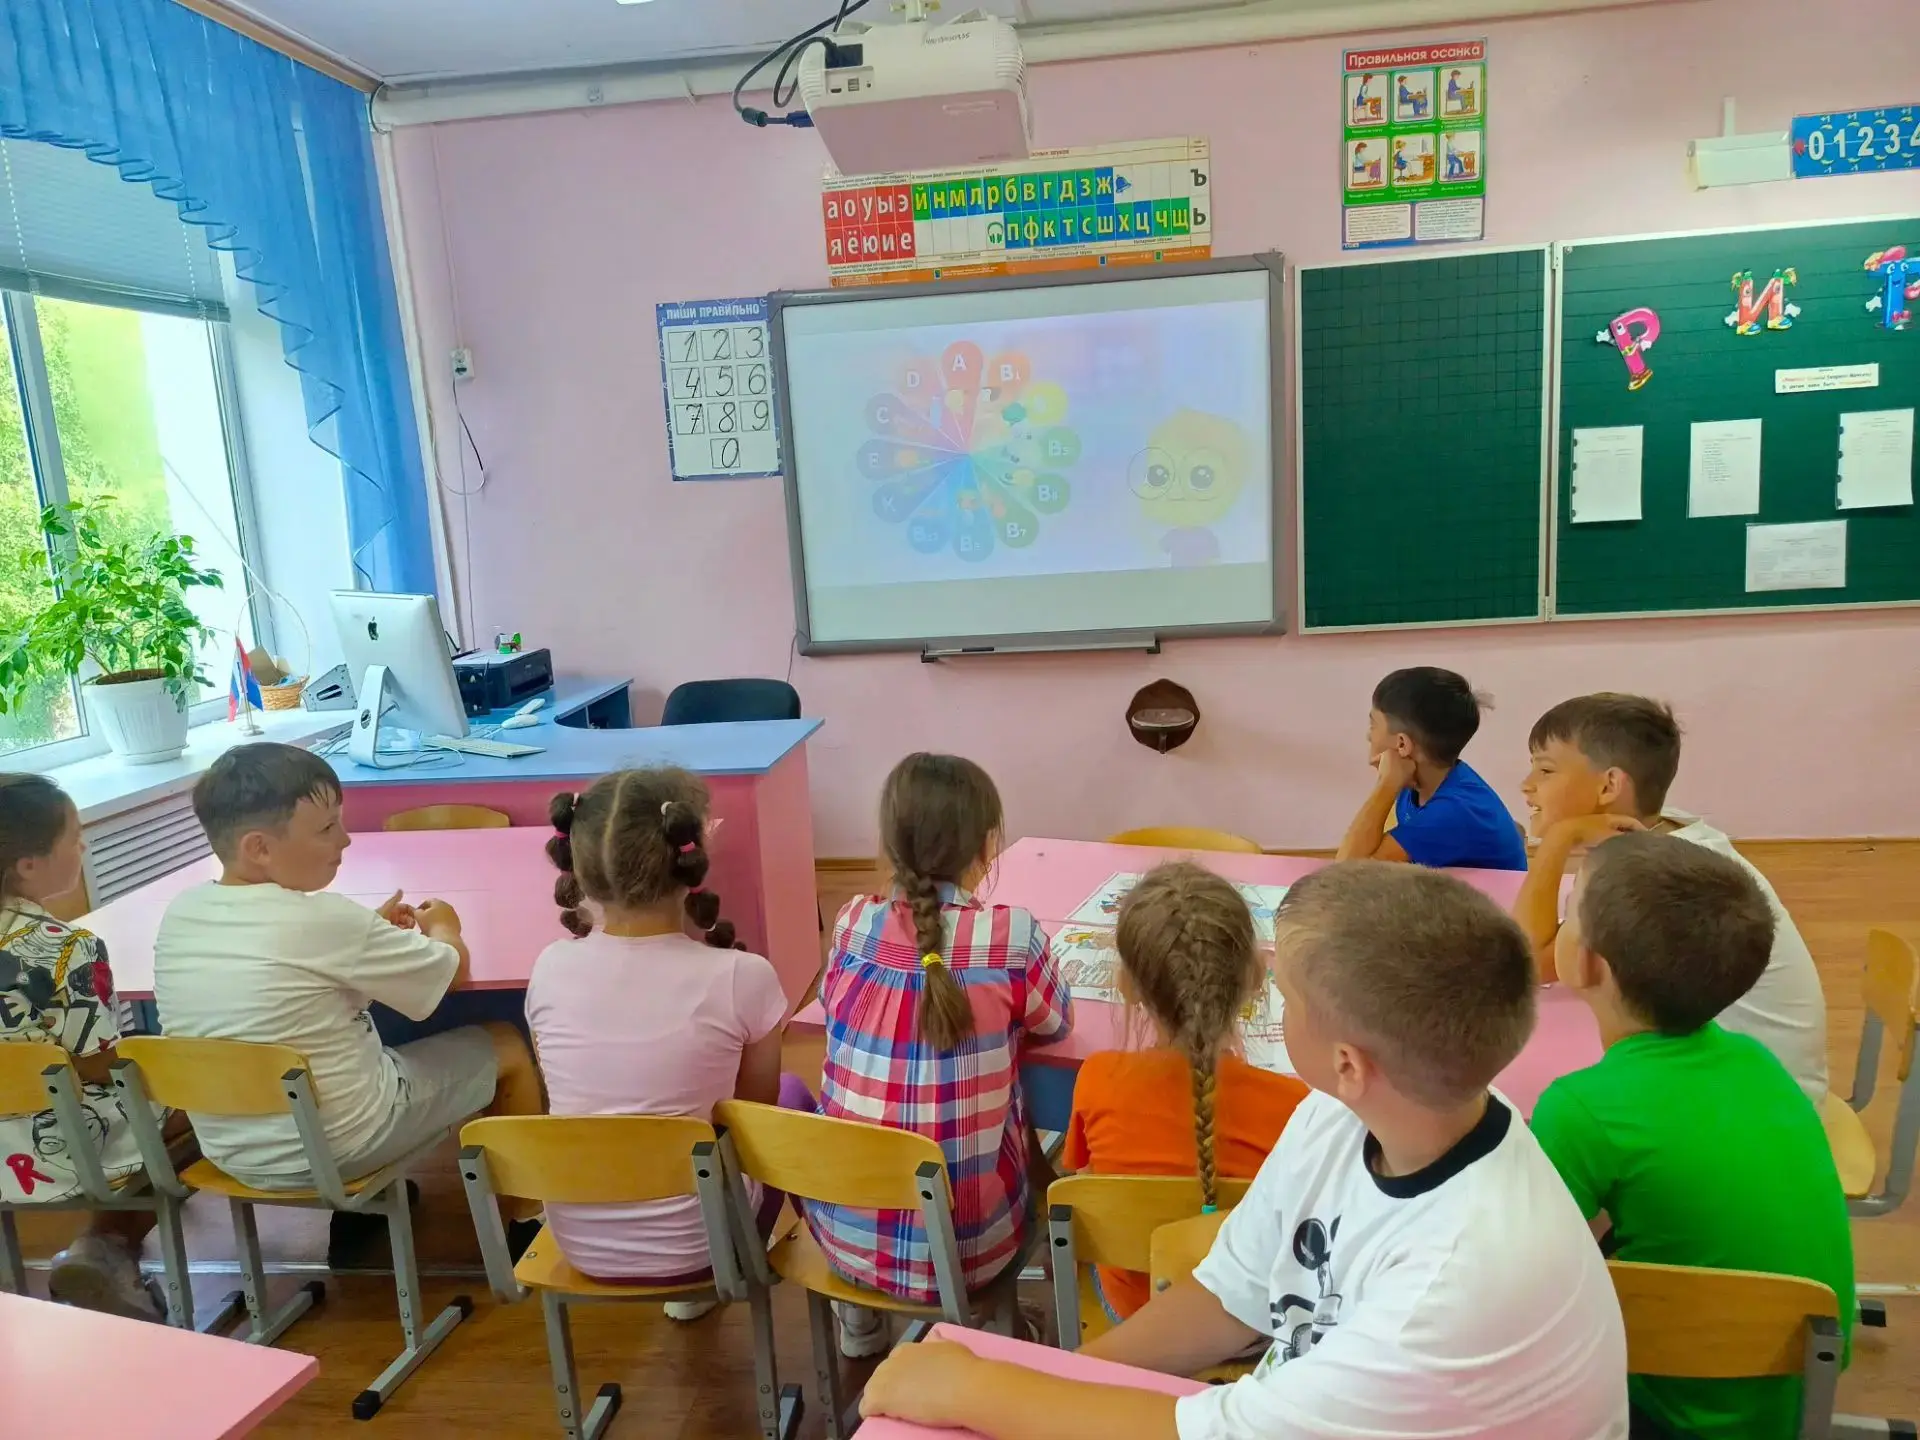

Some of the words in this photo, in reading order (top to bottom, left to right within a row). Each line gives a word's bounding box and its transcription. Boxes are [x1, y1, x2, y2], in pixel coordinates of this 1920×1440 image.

[1349, 50, 1427, 67] Правильная
[1431, 46, 1480, 59] осанка
[1808, 131, 1824, 160] 0
[1833, 128, 1846, 158] 1
[1857, 126, 1874, 156] 2
[1884, 124, 1901, 154] 3
[666, 307, 697, 320] ПИШИ
[699, 303, 760, 317] ПРАВИЛЬНО
[684, 331, 697, 362] 1
[713, 329, 731, 360] 2
[745, 327, 763, 358] 3
[952, 354, 967, 371] A
[685, 368, 700, 398] 4
[715, 365, 733, 396] 5
[748, 364, 767, 394] 6
[907, 371, 920, 388] D
[686, 403, 702, 434] 7
[718, 402, 735, 433] 8
[752, 400, 768, 431] 9
[721, 437, 739, 468] 0
[6, 1153, 55, 1195] R
